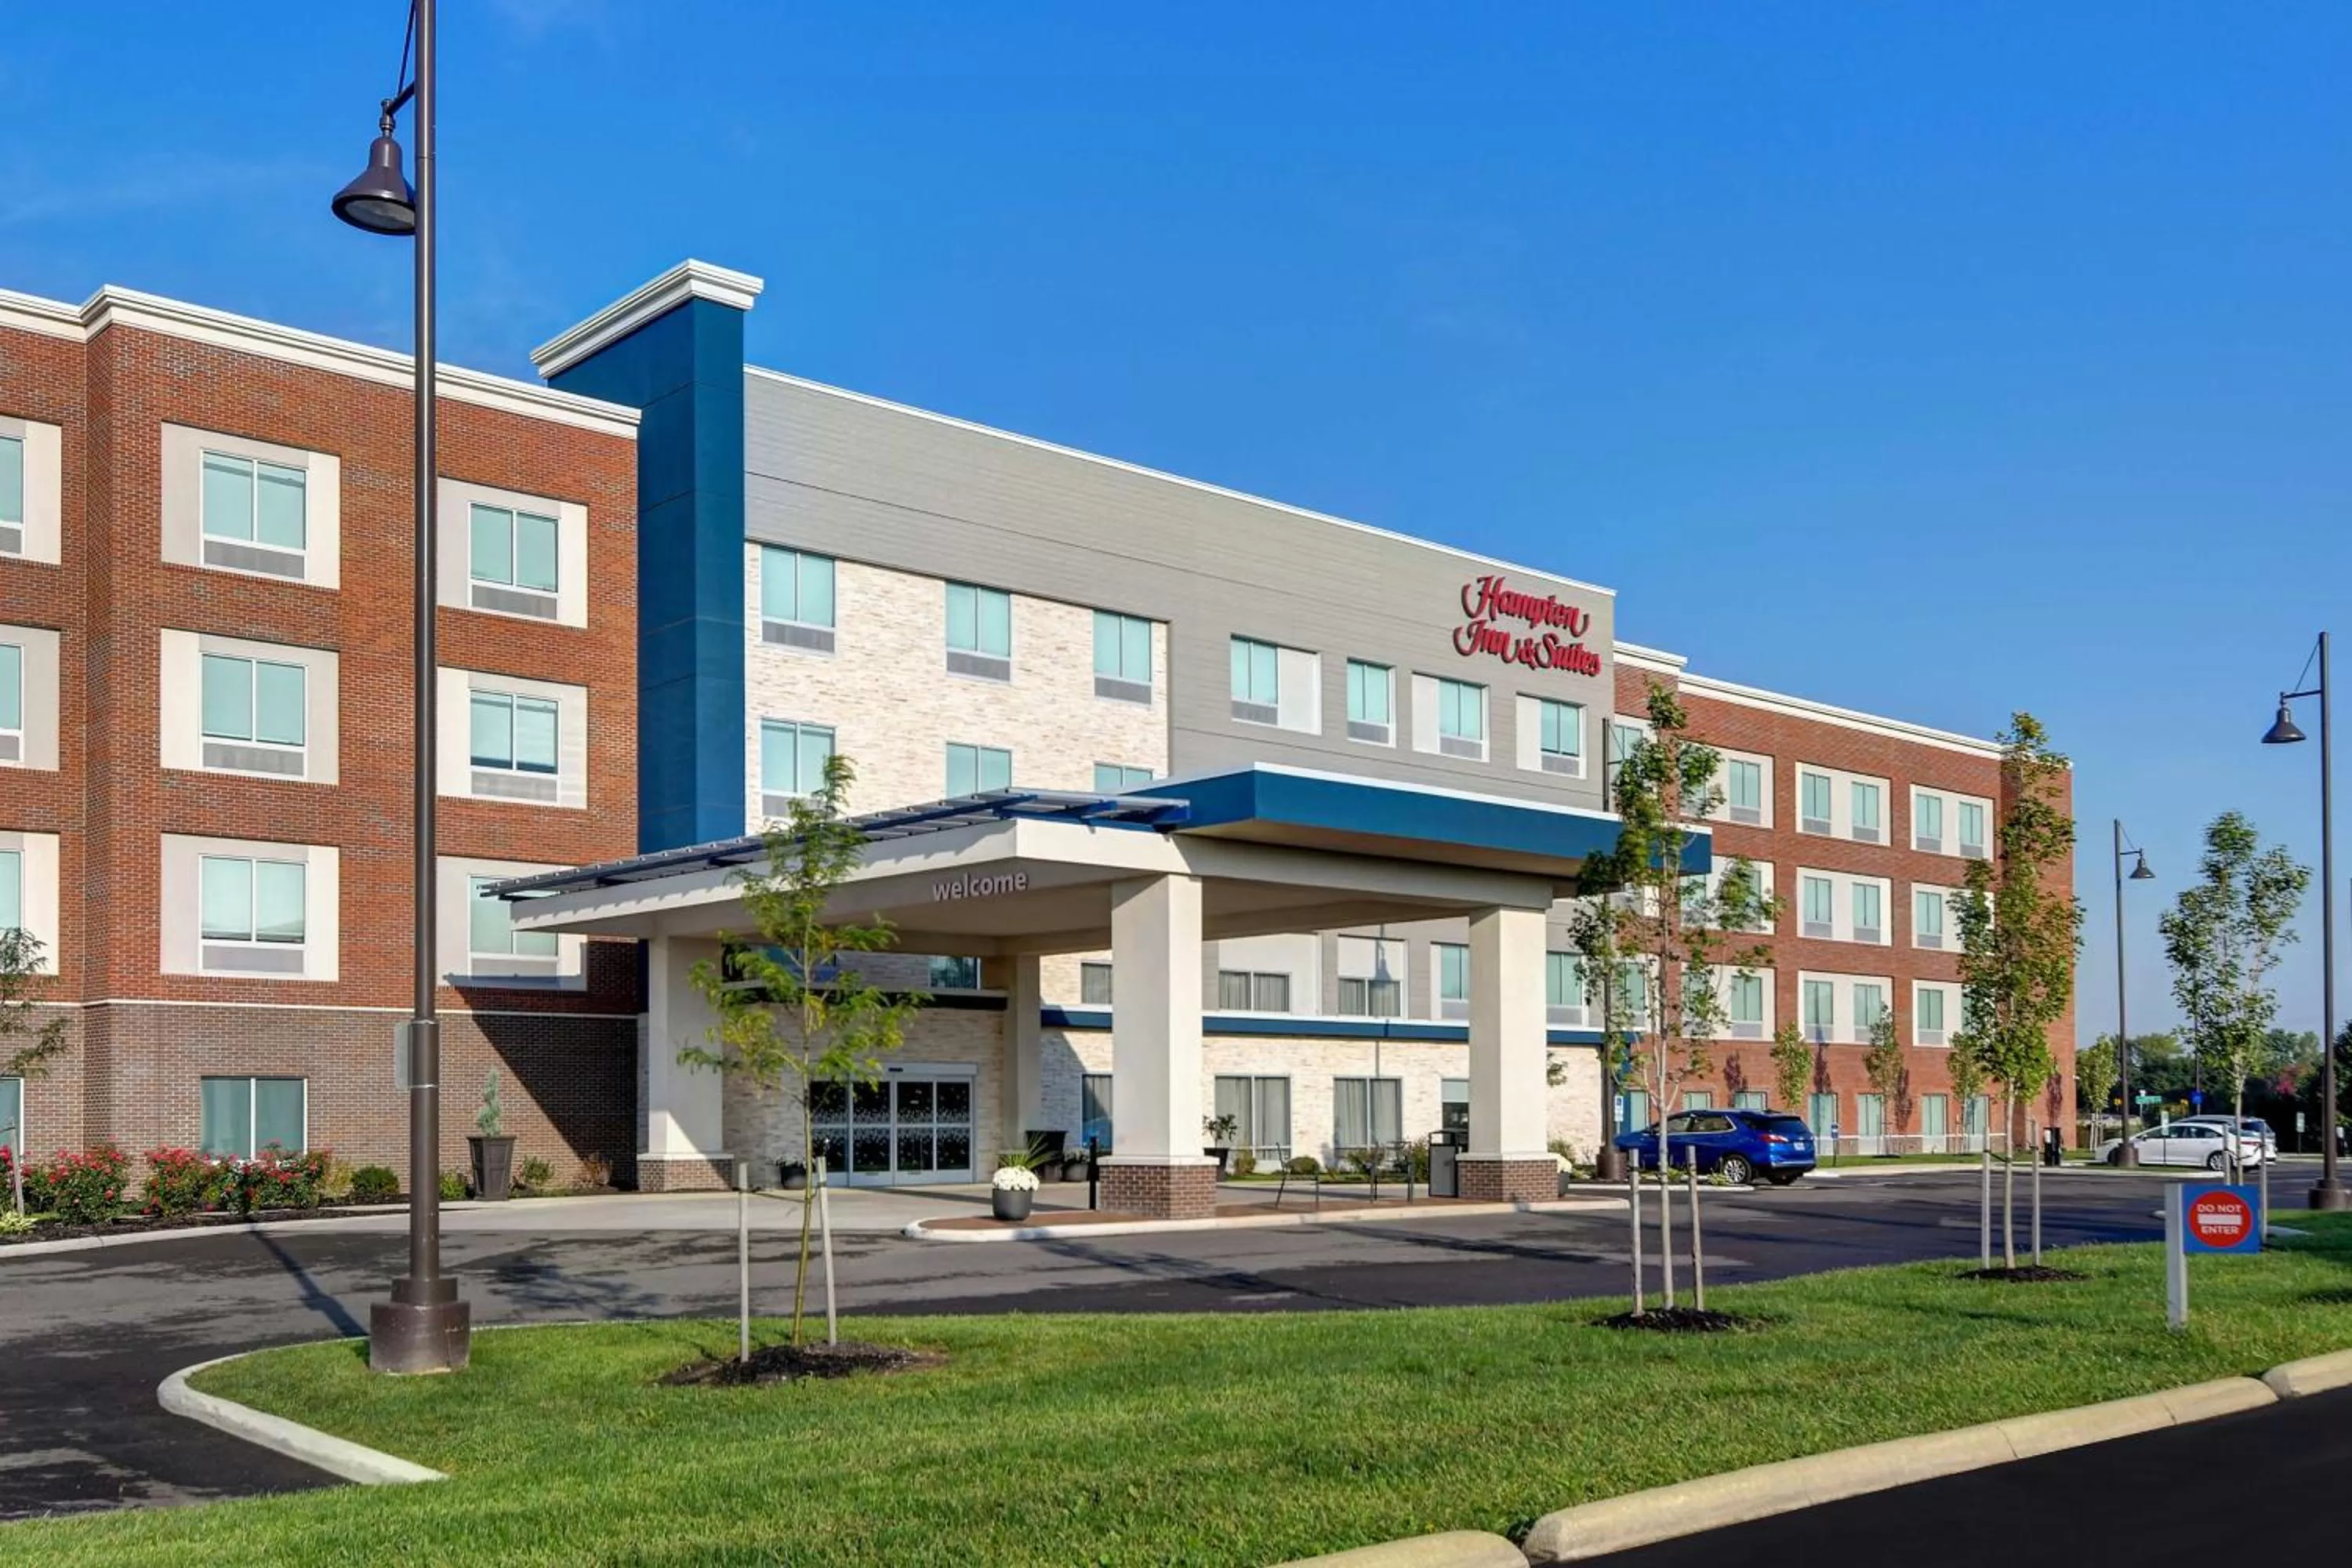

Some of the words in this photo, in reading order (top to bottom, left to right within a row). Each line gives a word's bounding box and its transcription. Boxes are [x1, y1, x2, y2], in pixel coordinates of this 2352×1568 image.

[1461, 575, 1590, 637] Hampton
[1453, 619, 1521, 663] Inn
[1534, 633, 1601, 677] Suites
[933, 872, 1029, 901] welcome
[2197, 1203, 2215, 1213] DO
[2218, 1203, 2241, 1213] NOT
[2201, 1225, 2239, 1235] ENTER
